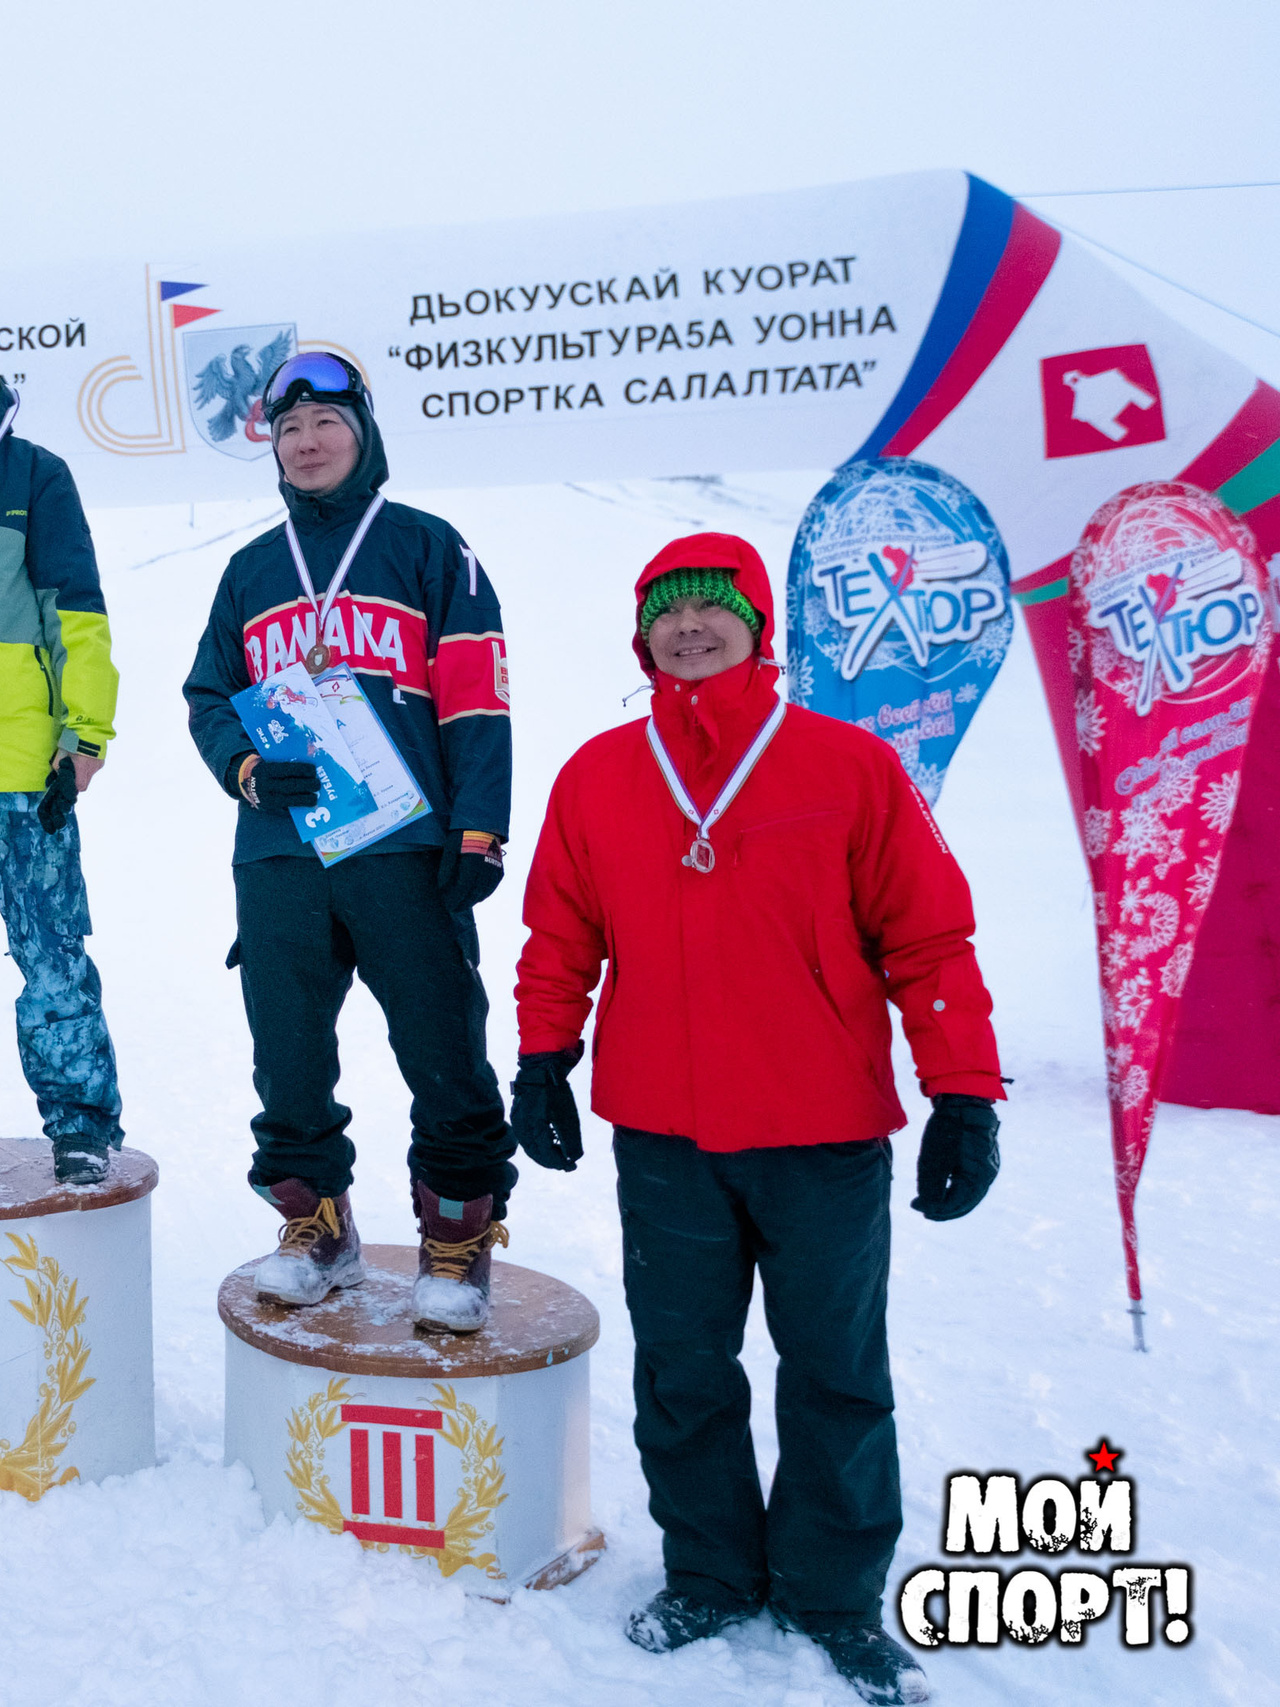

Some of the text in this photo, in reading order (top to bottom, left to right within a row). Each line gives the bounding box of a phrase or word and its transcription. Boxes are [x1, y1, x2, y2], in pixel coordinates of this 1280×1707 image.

[410, 256, 858, 325] ДЬОКУУСКАЙ КУОРАТ
[753, 304, 897, 346] УОННА
[421, 382, 605, 420] СПОРТКА
[245, 605, 408, 684] BANANA
[341, 1403, 445, 1549] III
